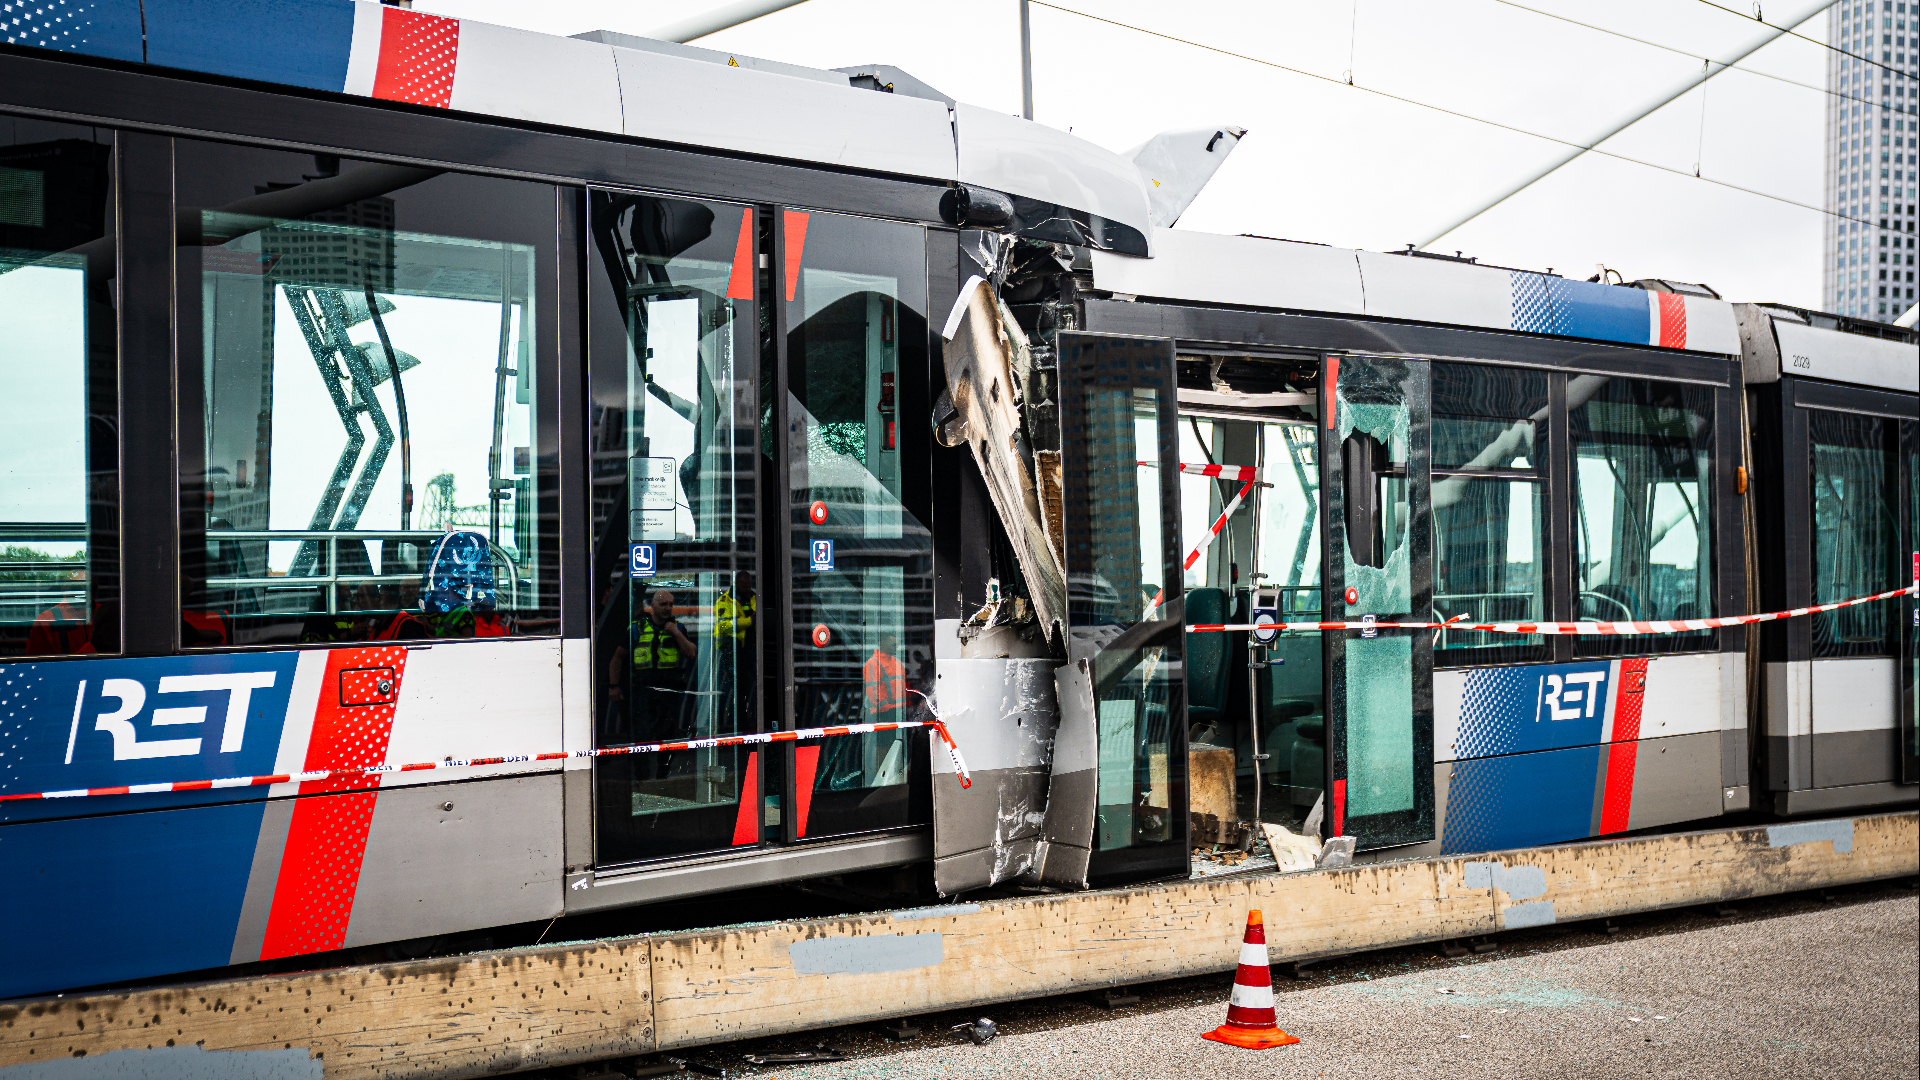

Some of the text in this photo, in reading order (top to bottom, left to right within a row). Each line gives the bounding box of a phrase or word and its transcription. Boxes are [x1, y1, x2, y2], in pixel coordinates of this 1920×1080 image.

[1792, 354, 1811, 369] 2029
[95, 671, 277, 761] RET
[1545, 670, 1606, 721] RET
